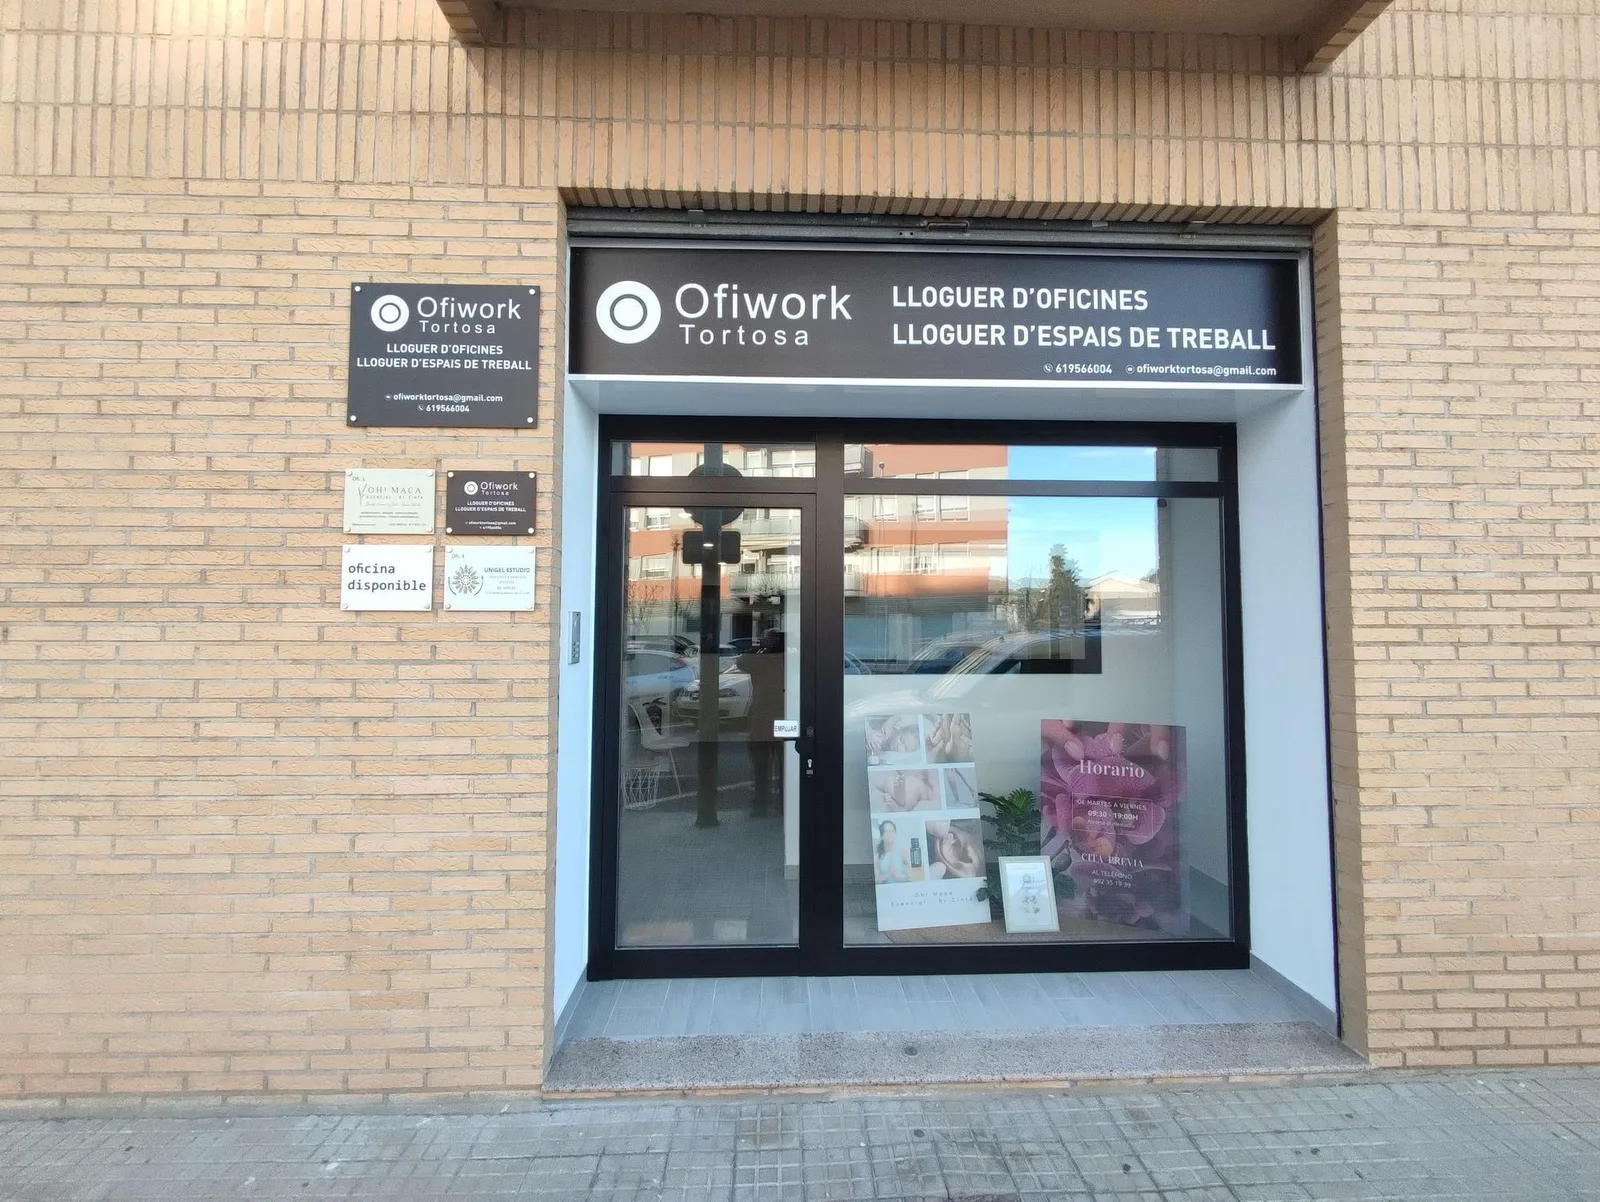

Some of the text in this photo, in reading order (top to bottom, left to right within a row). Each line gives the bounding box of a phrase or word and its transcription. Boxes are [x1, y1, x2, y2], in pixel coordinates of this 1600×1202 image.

[675, 283, 852, 320] Ofiwork
[892, 286, 1148, 311] LLOGUER D'OFICINES
[417, 296, 522, 320] Ofiwork
[419, 320, 496, 334] Tortosa
[679, 324, 809, 346] Tortosa
[893, 324, 1276, 350] LLOGUER D'ESPAIS DE TREBALL
[386, 344, 438, 354] LLOGUER
[356, 358, 408, 368] LLOGUER
[464, 360, 479, 369] DE
[482, 360, 532, 370] TREBALL
[1056, 363, 1277, 378] 619566004 ofiworktortosa@gmail.com
[393, 393, 503, 403] ofiworktortosa@gmail.com
[426, 404, 470, 412] 619566004
[480, 482, 518, 490] Ofiwork
[348, 563, 395, 574] oficina
[348, 580, 426, 593] disponible
[1080, 760, 1145, 778] Horario
[1120, 802, 1147, 811] VIERNES
[1113, 812, 1138, 820] 19:00H
[1081, 853, 1144, 868] CITA PREVIA
